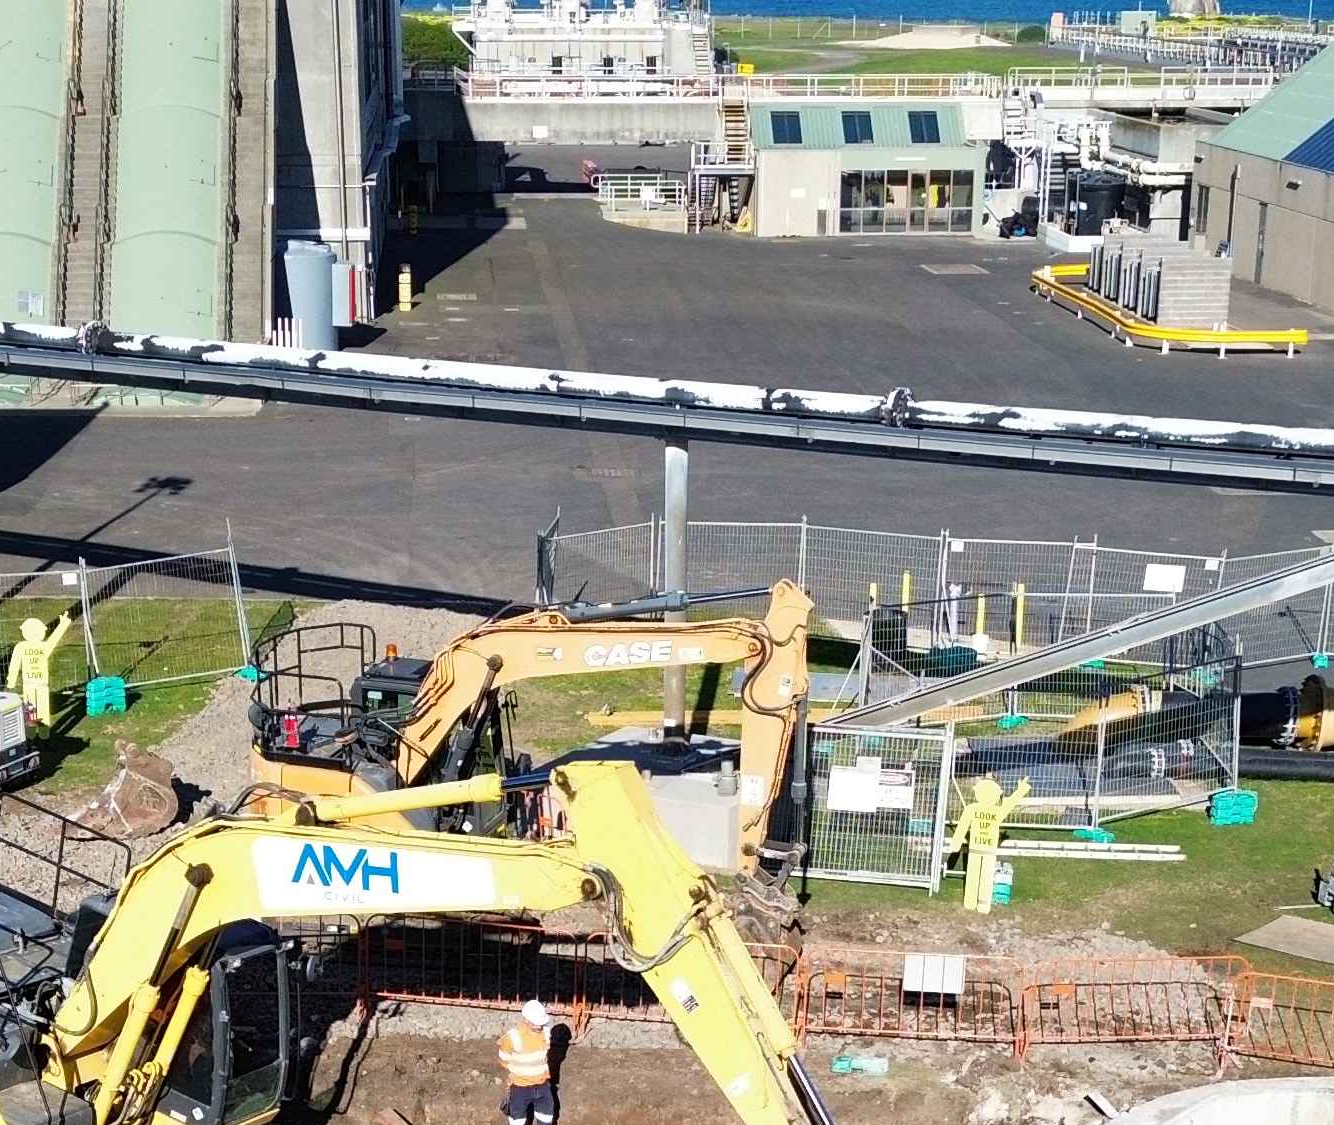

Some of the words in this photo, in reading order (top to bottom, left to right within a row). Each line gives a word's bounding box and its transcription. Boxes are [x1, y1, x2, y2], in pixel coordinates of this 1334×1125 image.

[24, 648, 44, 656] LOOK
[583, 640, 673, 667] CASE
[26, 672, 44, 680] LIVE
[974, 812, 997, 822] LOOK
[974, 837, 994, 846] LIVE
[291, 843, 399, 894] AMH
[324, 891, 365, 904] CIVIL
